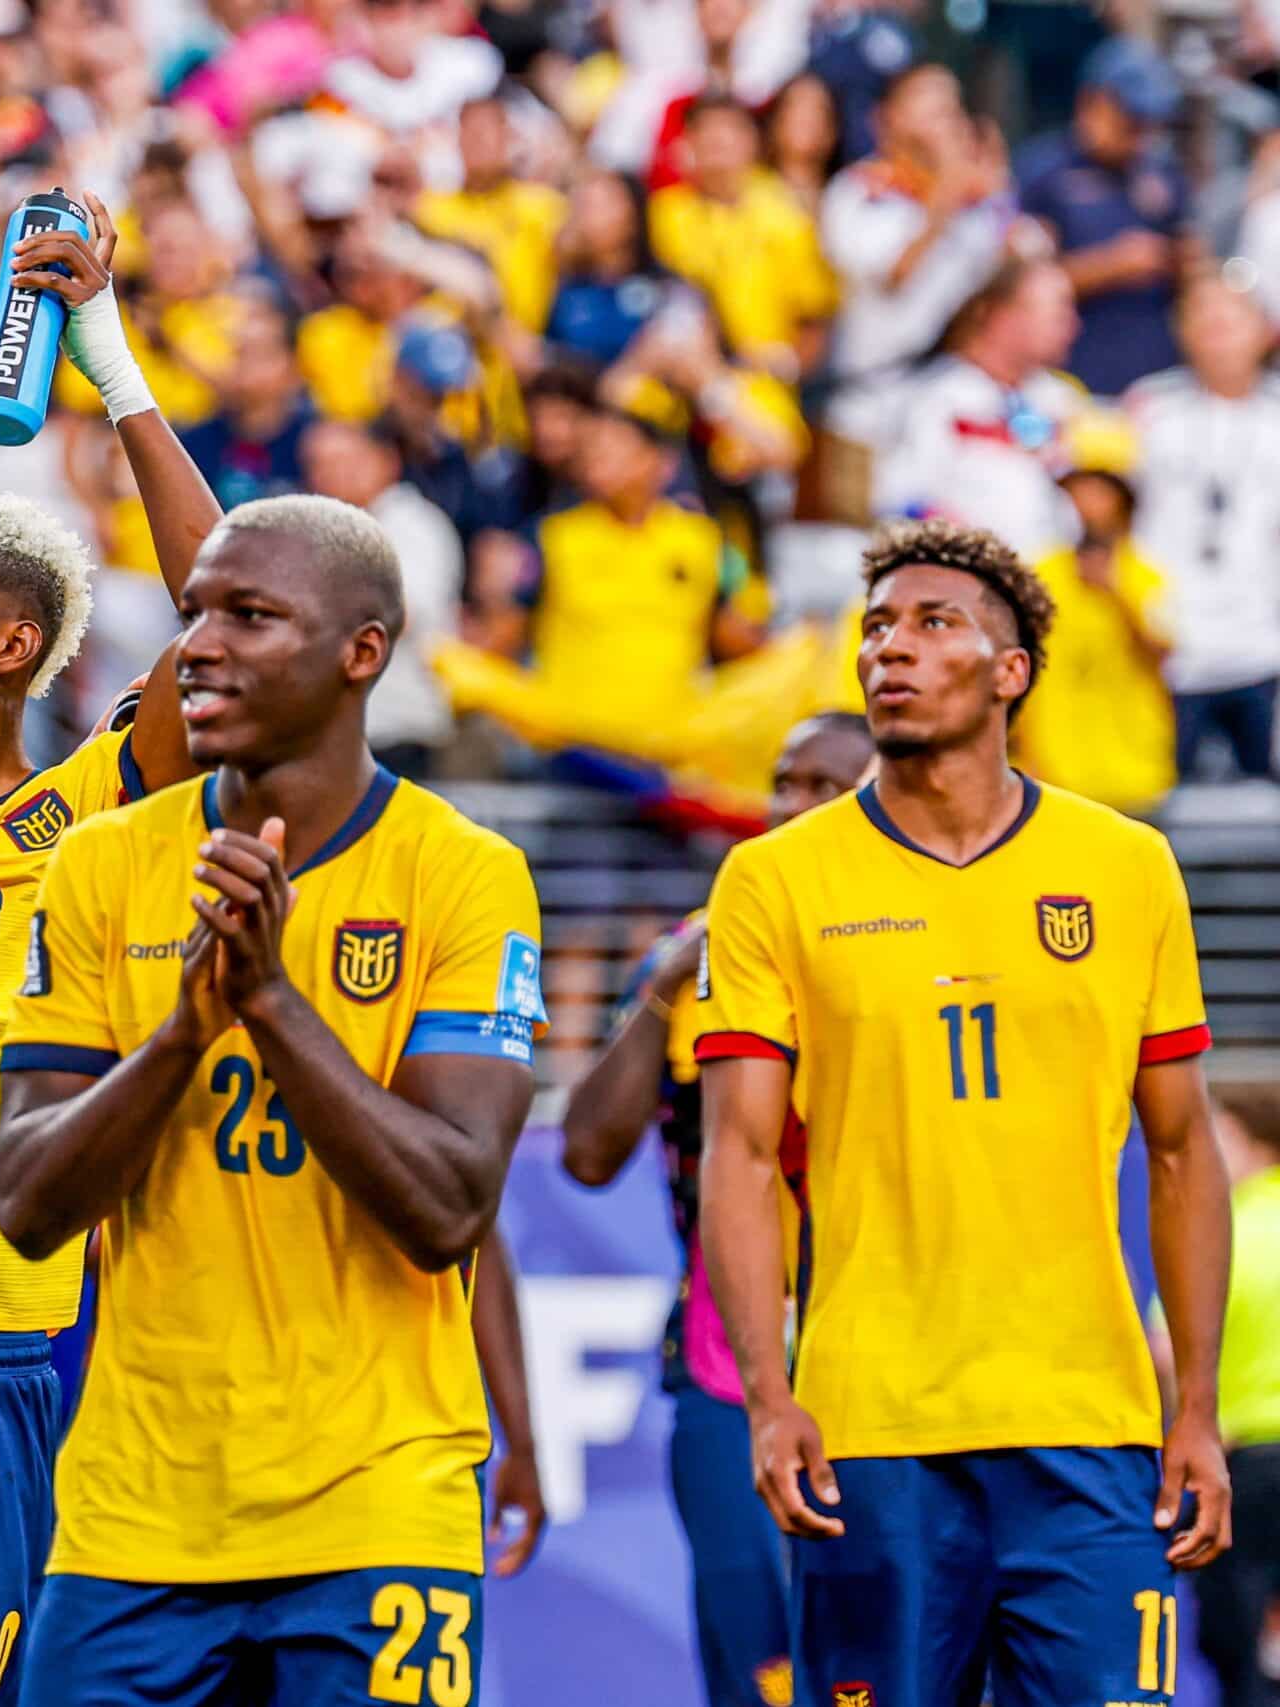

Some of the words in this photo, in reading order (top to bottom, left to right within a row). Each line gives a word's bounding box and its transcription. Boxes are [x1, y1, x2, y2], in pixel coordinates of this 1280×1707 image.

[821, 916, 928, 941] marathon
[939, 1002, 1000, 1100] 11
[210, 1054, 306, 1177] 23
[369, 1582, 472, 1707] 23
[1133, 1589, 1177, 1696] 11
